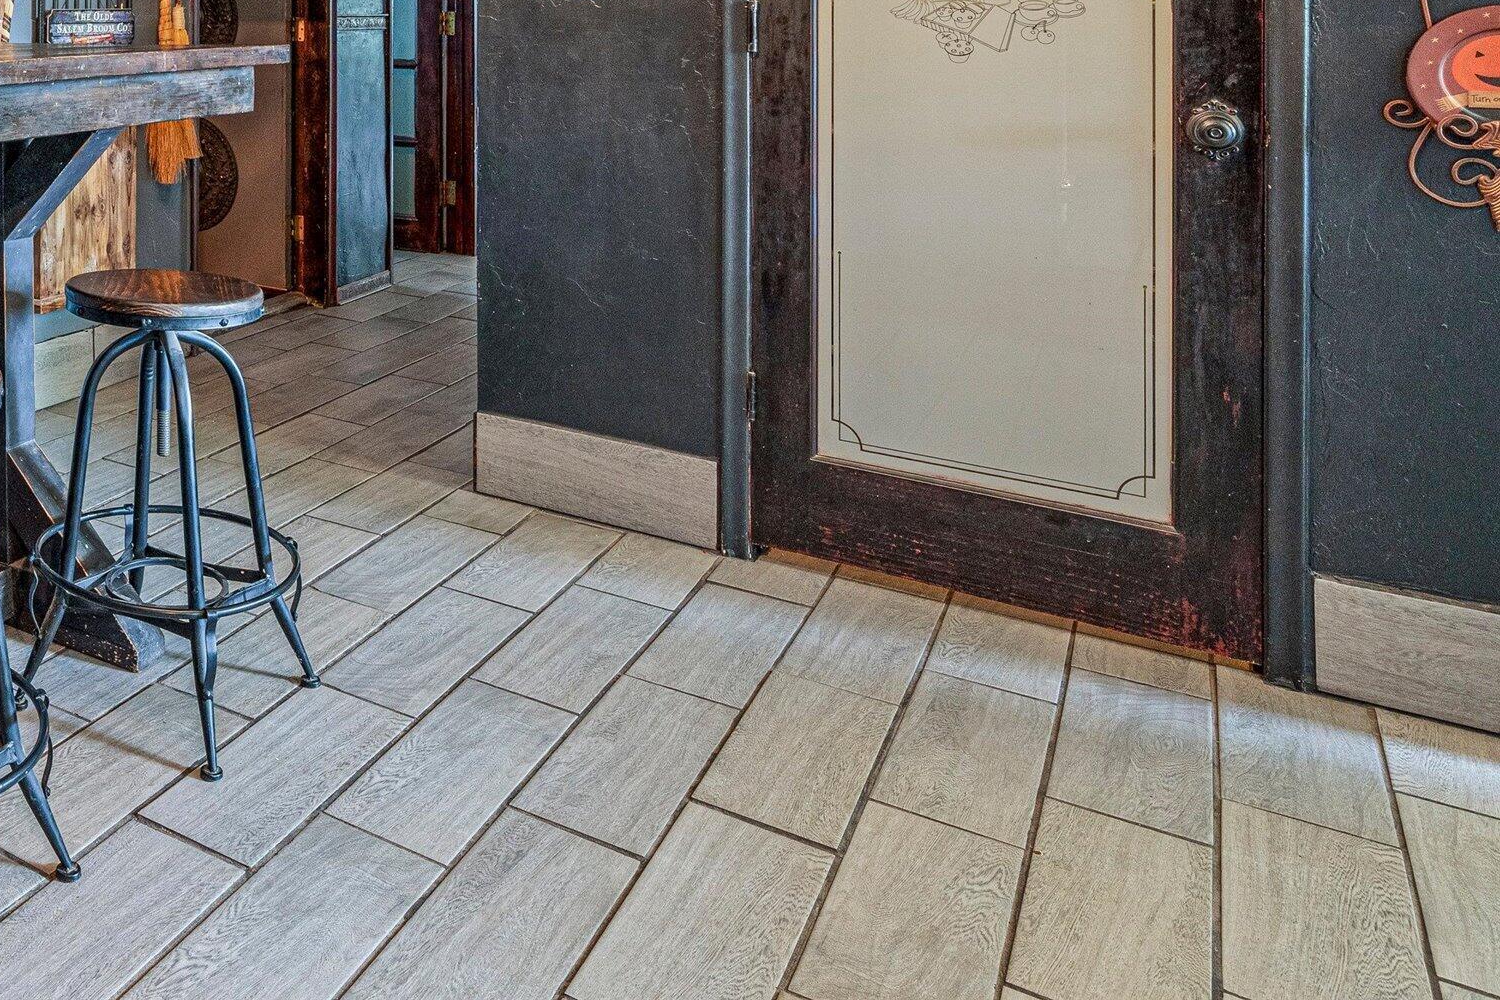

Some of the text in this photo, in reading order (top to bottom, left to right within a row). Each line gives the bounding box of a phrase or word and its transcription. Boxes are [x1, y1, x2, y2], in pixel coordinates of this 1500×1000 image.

[74, 11, 115, 21] THE OLDE
[56, 22, 84, 33] SALEM
[87, 23, 115, 33] BROOM
[1471, 94, 1491, 104] Turn
